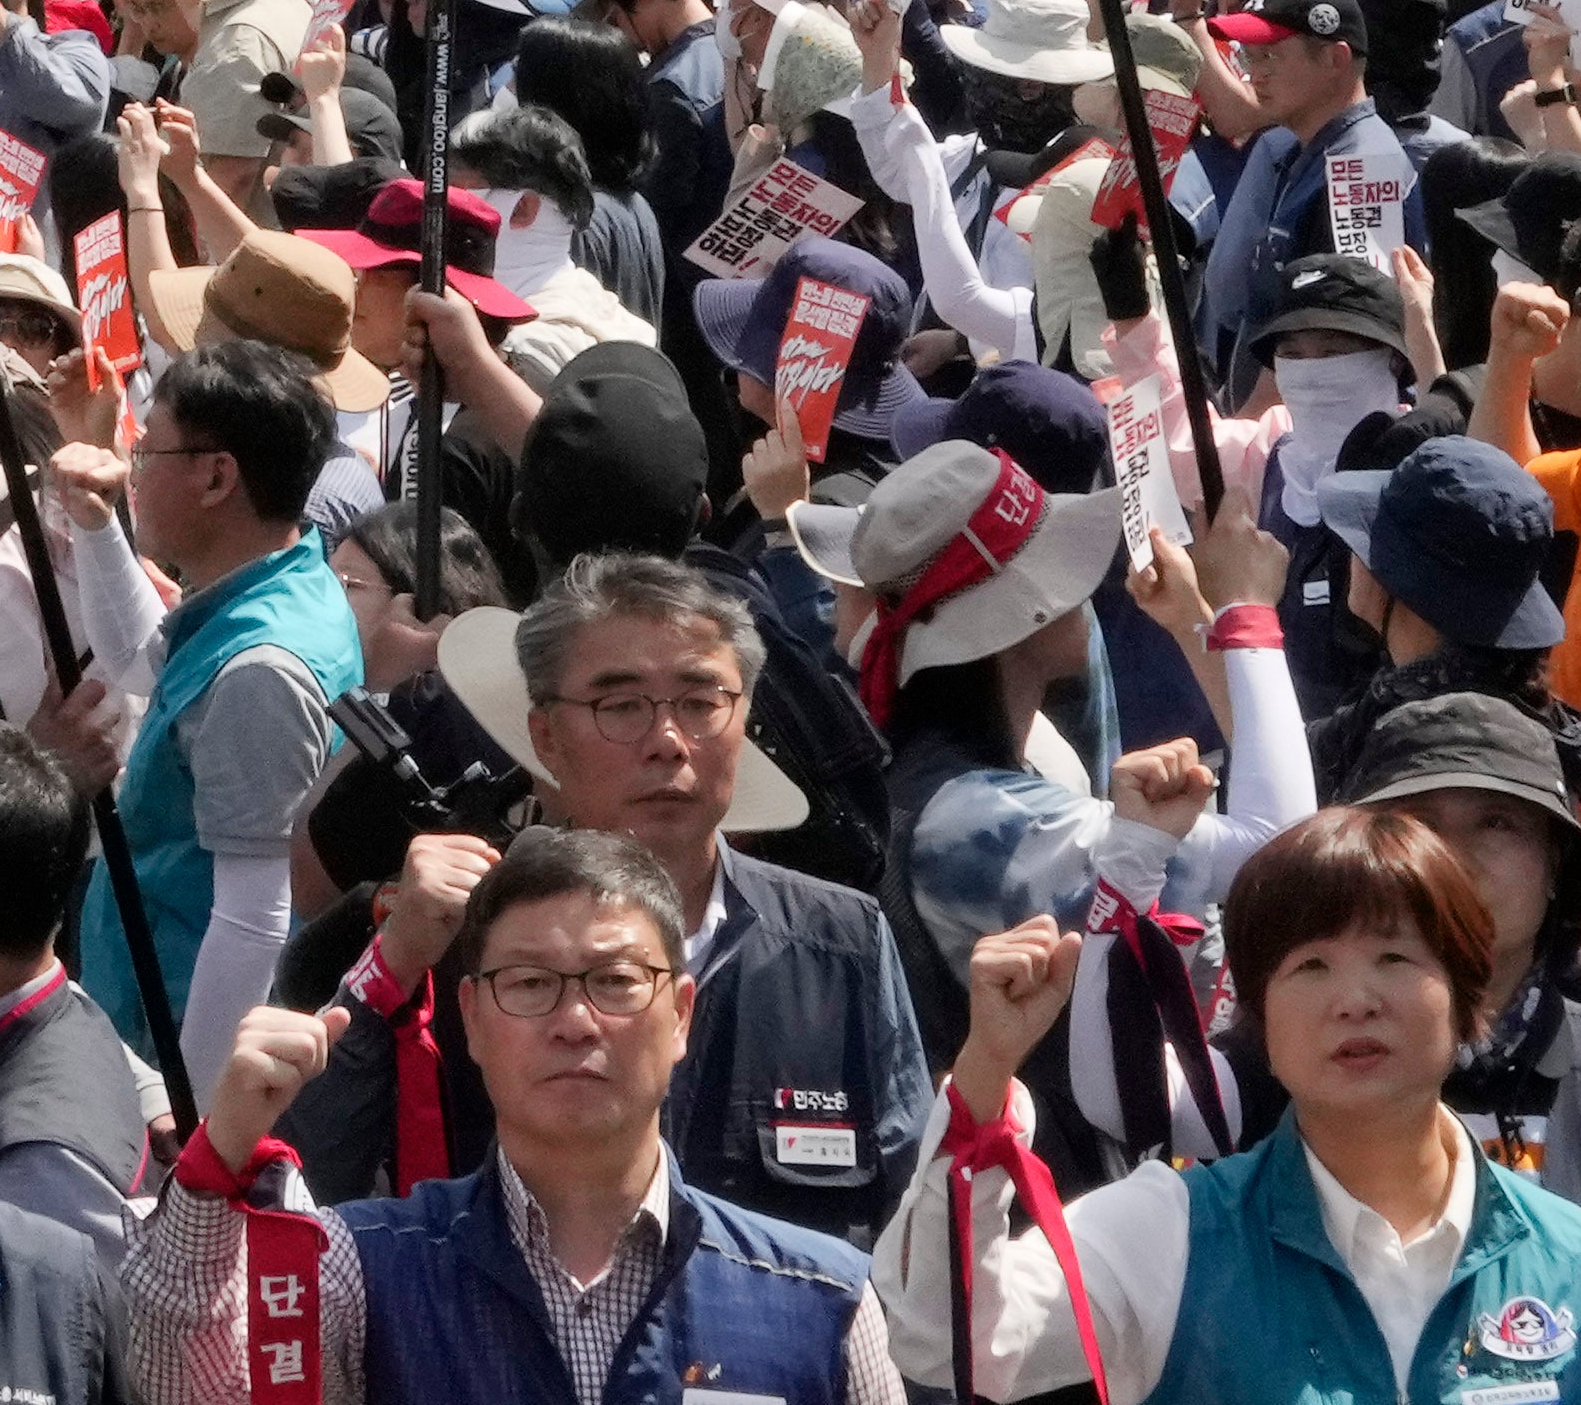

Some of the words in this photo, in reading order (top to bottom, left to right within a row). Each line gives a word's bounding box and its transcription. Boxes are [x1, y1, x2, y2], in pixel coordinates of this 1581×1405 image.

[430, 43, 451, 194] www.jangtoo.com
[776, 163, 819, 199] 모든
[1330, 159, 1364, 183] 모든
[750, 176, 841, 236] 노동자의
[1332, 181, 1400, 206] 노동자의
[739, 198, 802, 244] 노동권
[1334, 204, 1382, 231] 노동권
[697, 233, 761, 273] 하라!
[792, 1090, 849, 1112] 민주노총
[259, 1273, 306, 1385] 단결
